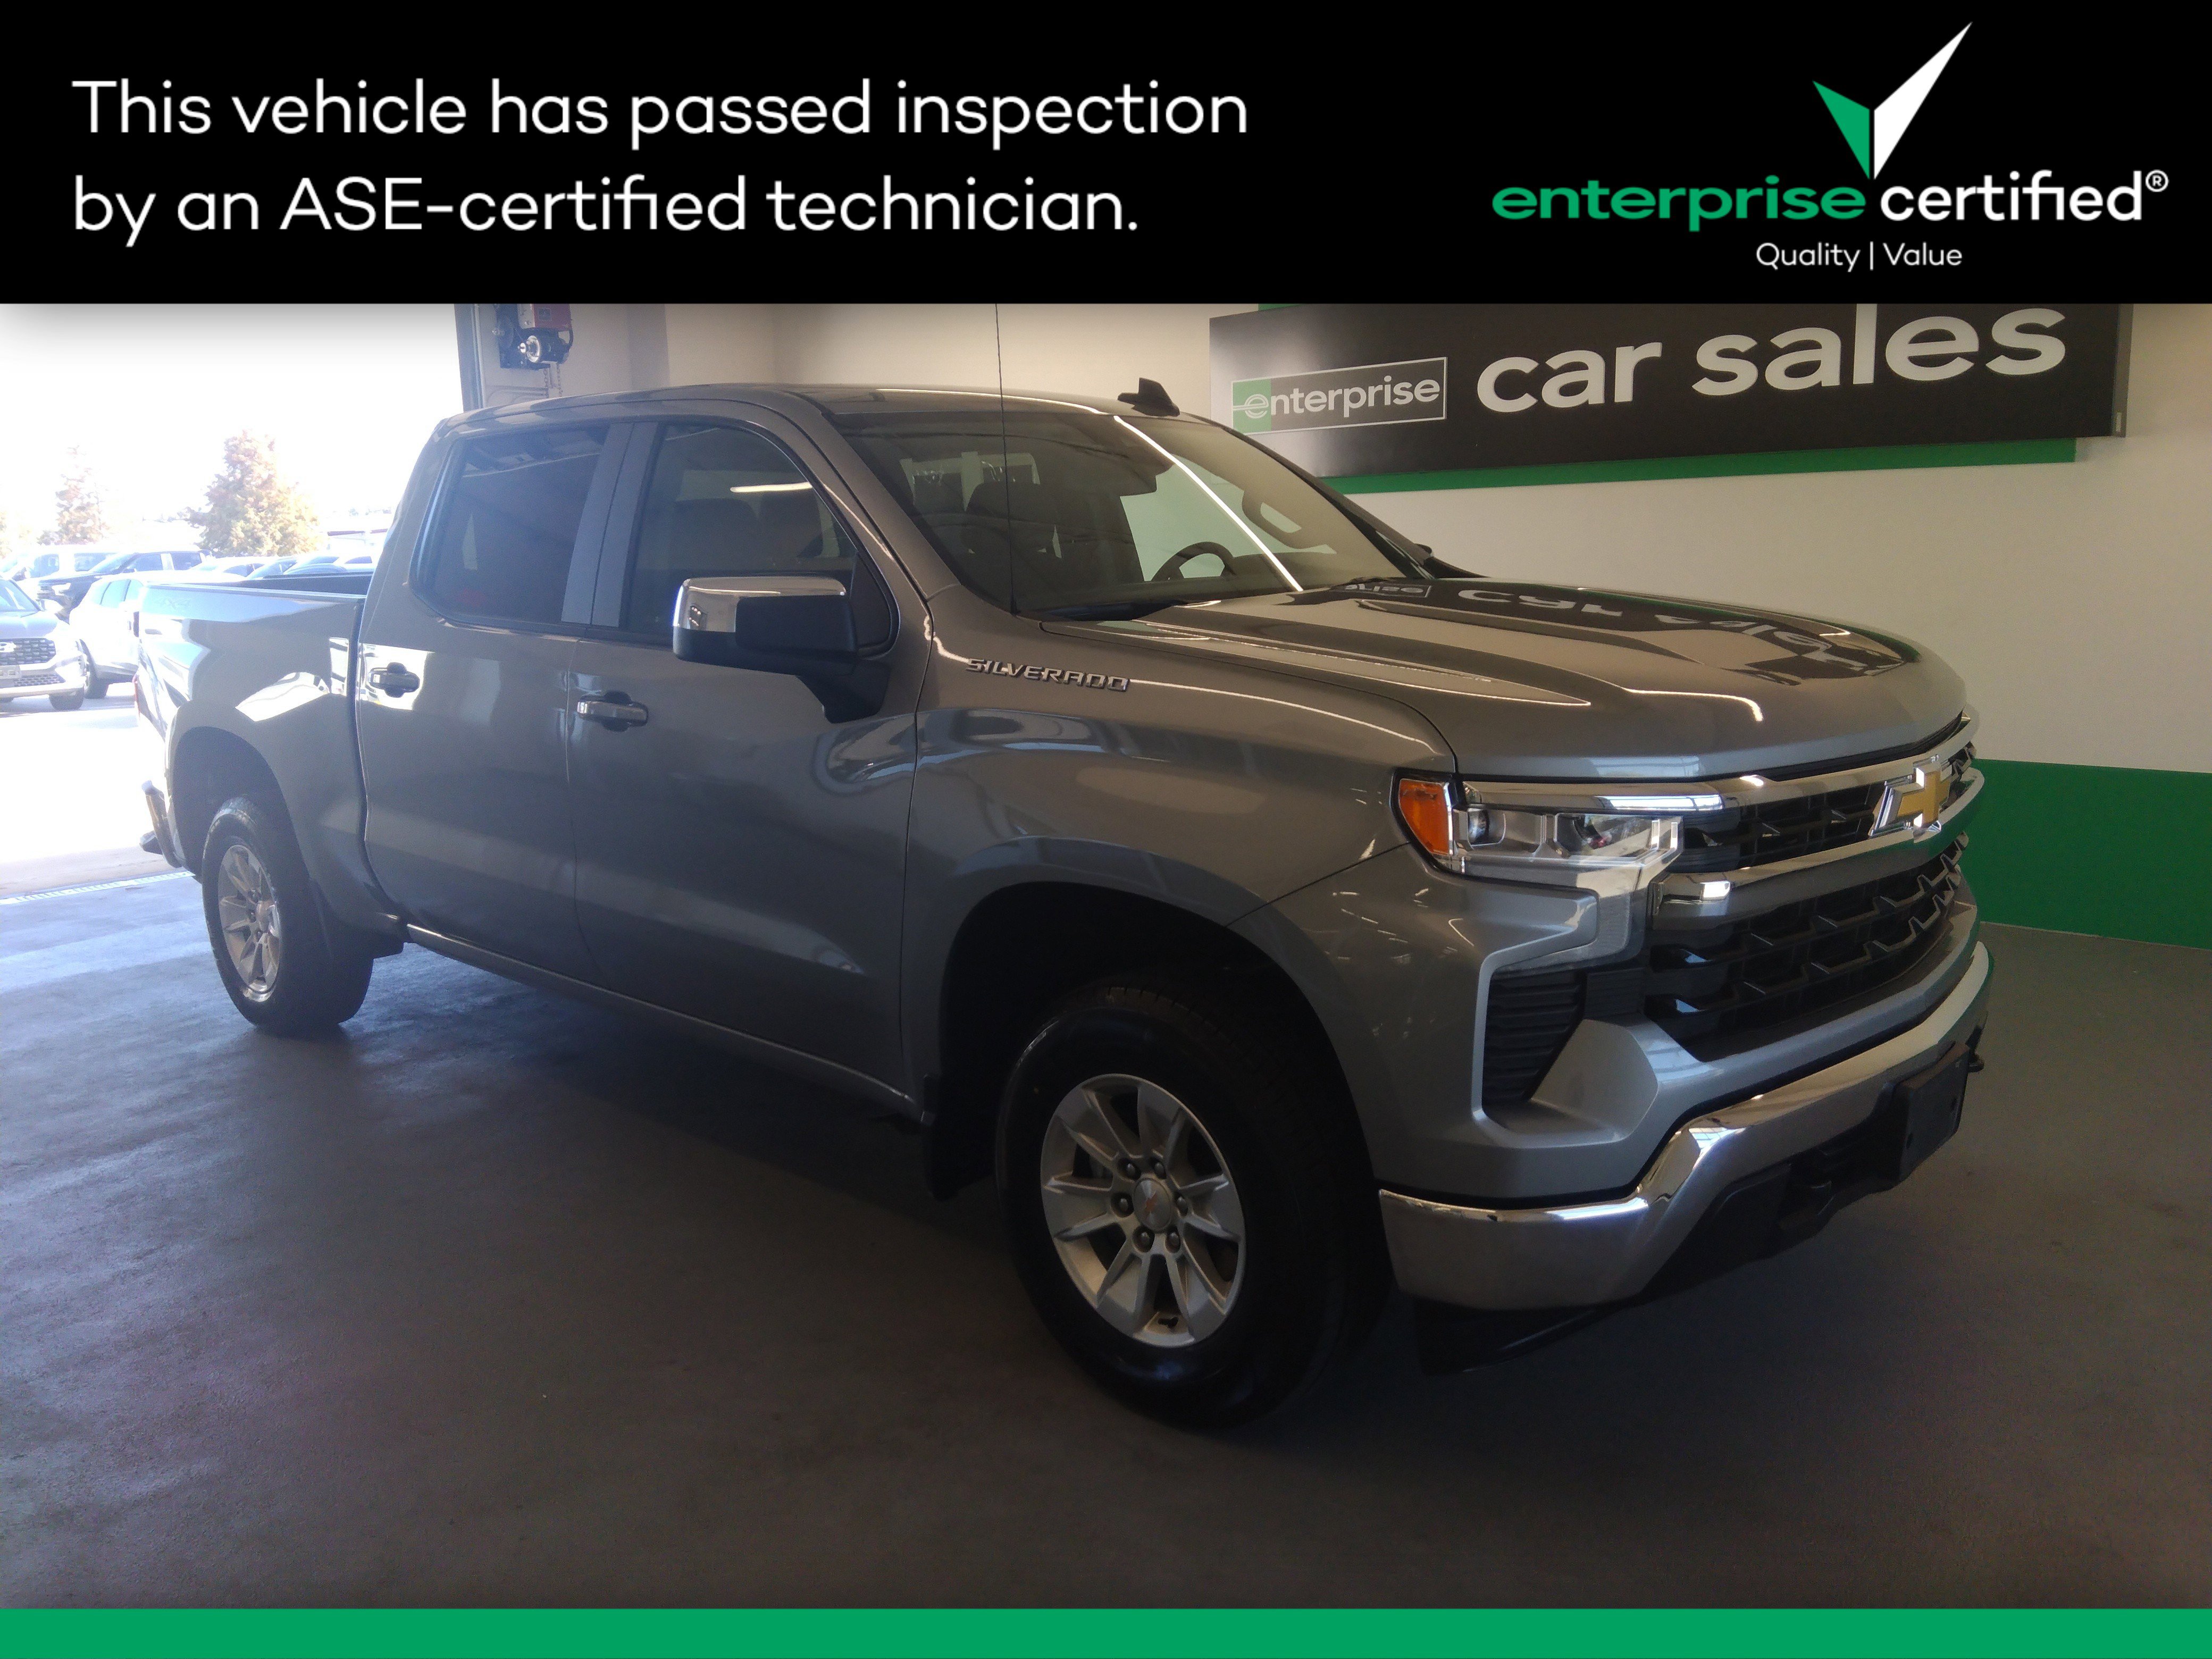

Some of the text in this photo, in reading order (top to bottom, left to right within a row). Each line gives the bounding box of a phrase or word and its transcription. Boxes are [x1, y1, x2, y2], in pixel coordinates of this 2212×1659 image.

[1477, 304, 2066, 412] car sales
[1233, 375, 1440, 418] enterprise
[966, 658, 1130, 692] SILVERADO
